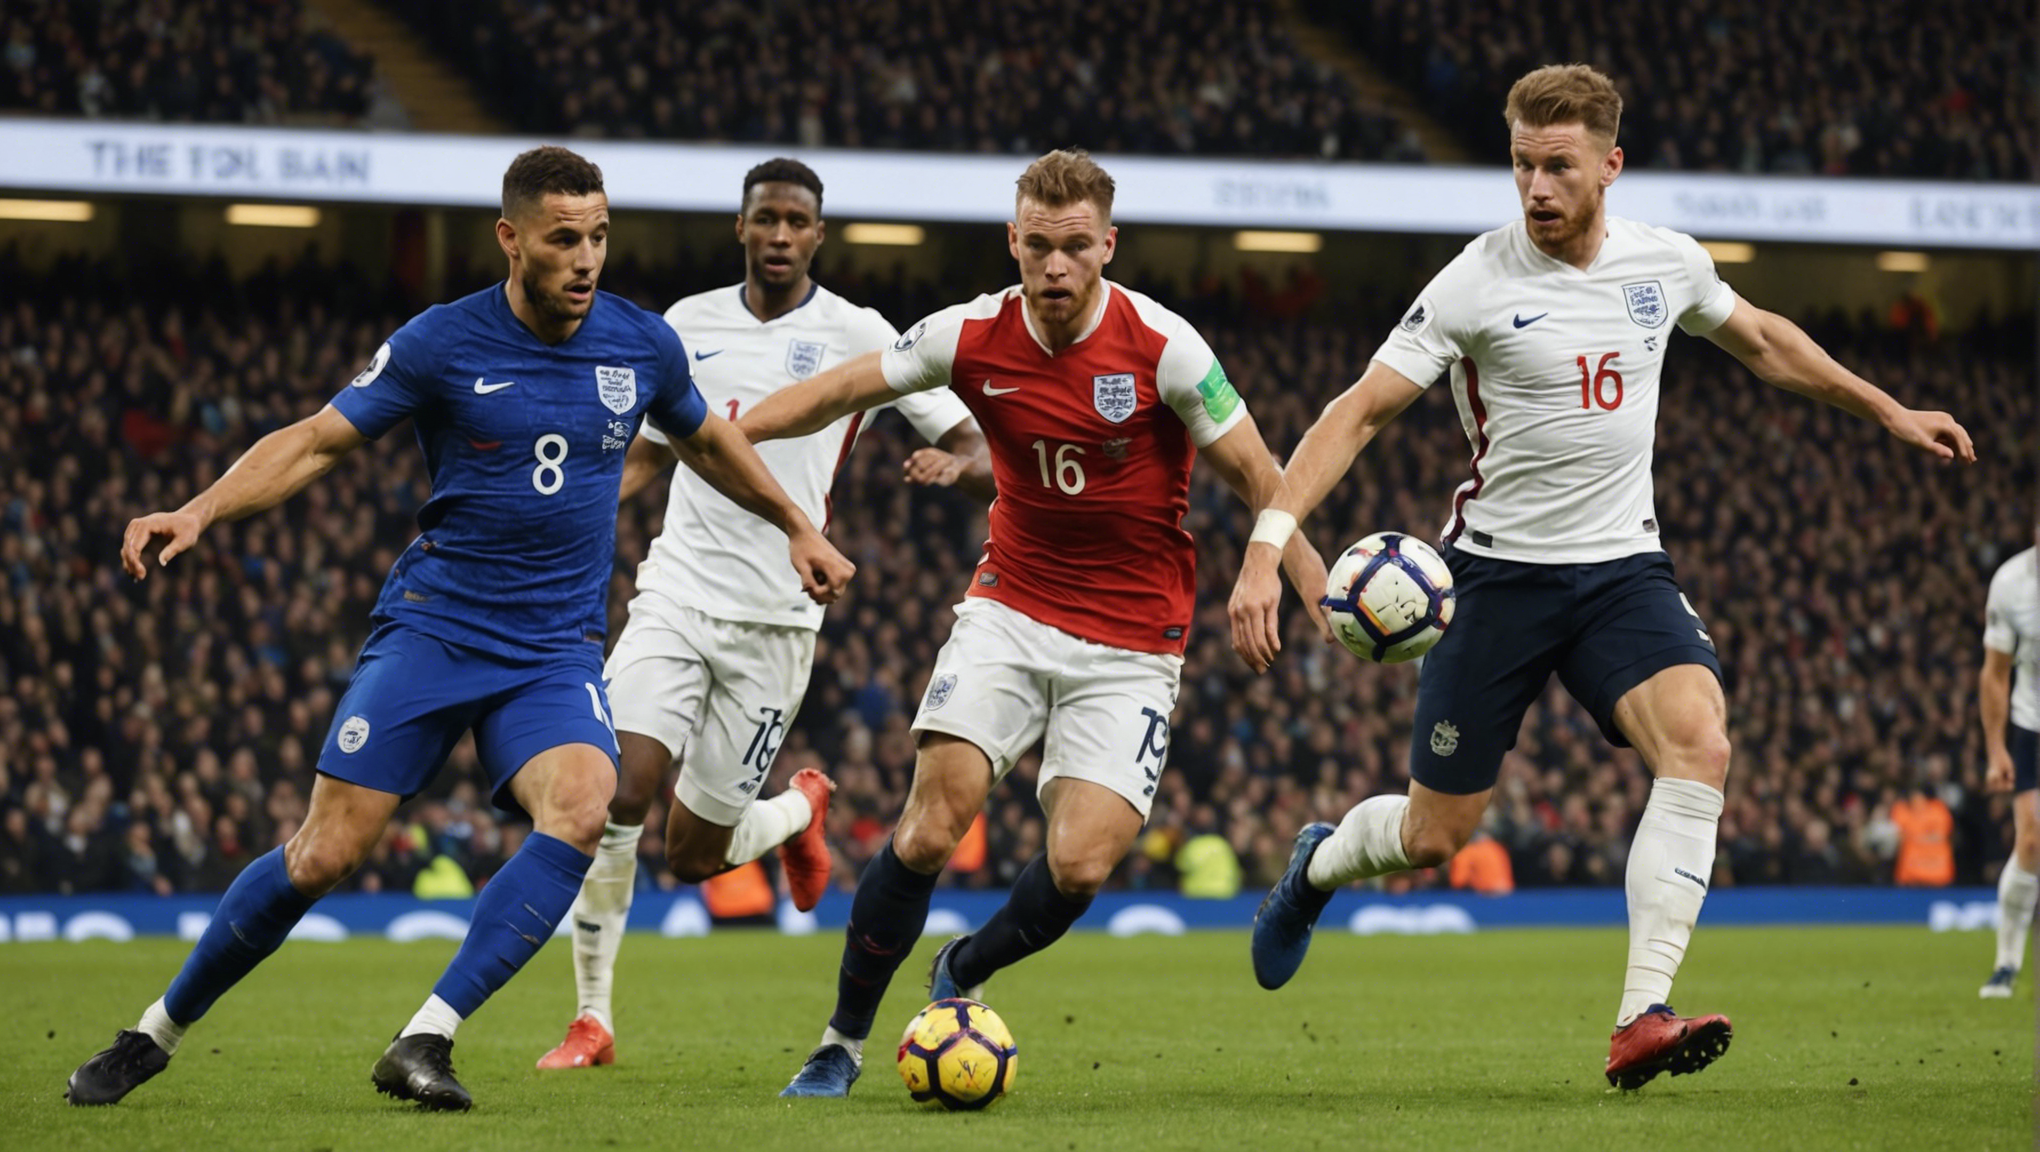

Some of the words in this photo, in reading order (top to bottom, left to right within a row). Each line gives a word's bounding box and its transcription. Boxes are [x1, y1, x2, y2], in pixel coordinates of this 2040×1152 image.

[86, 140, 169, 178] THE
[1577, 352, 1623, 411] 16
[532, 434, 569, 495] 8
[1032, 439, 1086, 495] 16
